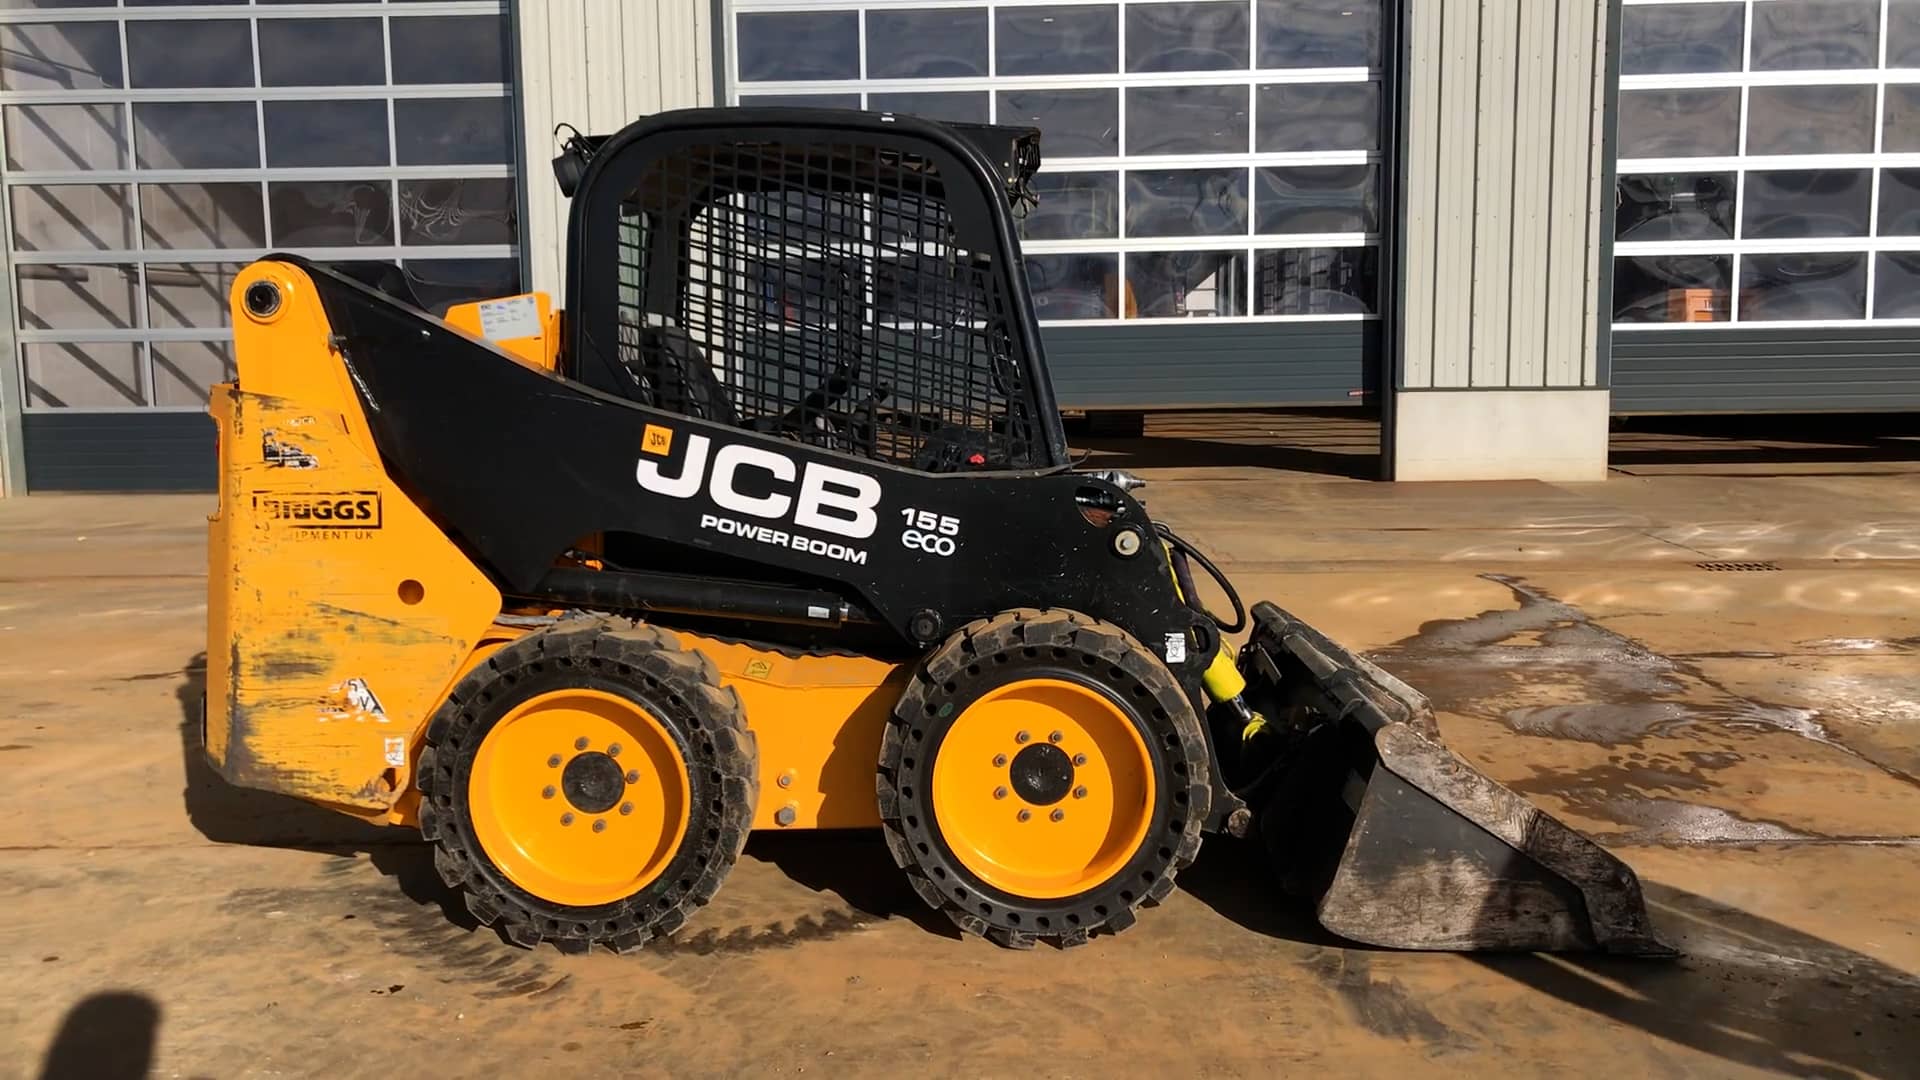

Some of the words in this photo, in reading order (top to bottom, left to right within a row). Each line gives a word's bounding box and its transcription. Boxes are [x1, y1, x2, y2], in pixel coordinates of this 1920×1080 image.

[651, 432, 665, 446] JCB
[636, 434, 882, 539] JCB
[284, 530, 348, 540] IPMENT
[355, 530, 373, 540] UK
[901, 507, 960, 536] 155
[700, 514, 789, 548] POWER
[791, 535, 868, 565] BOOM
[901, 529, 957, 557] eco
